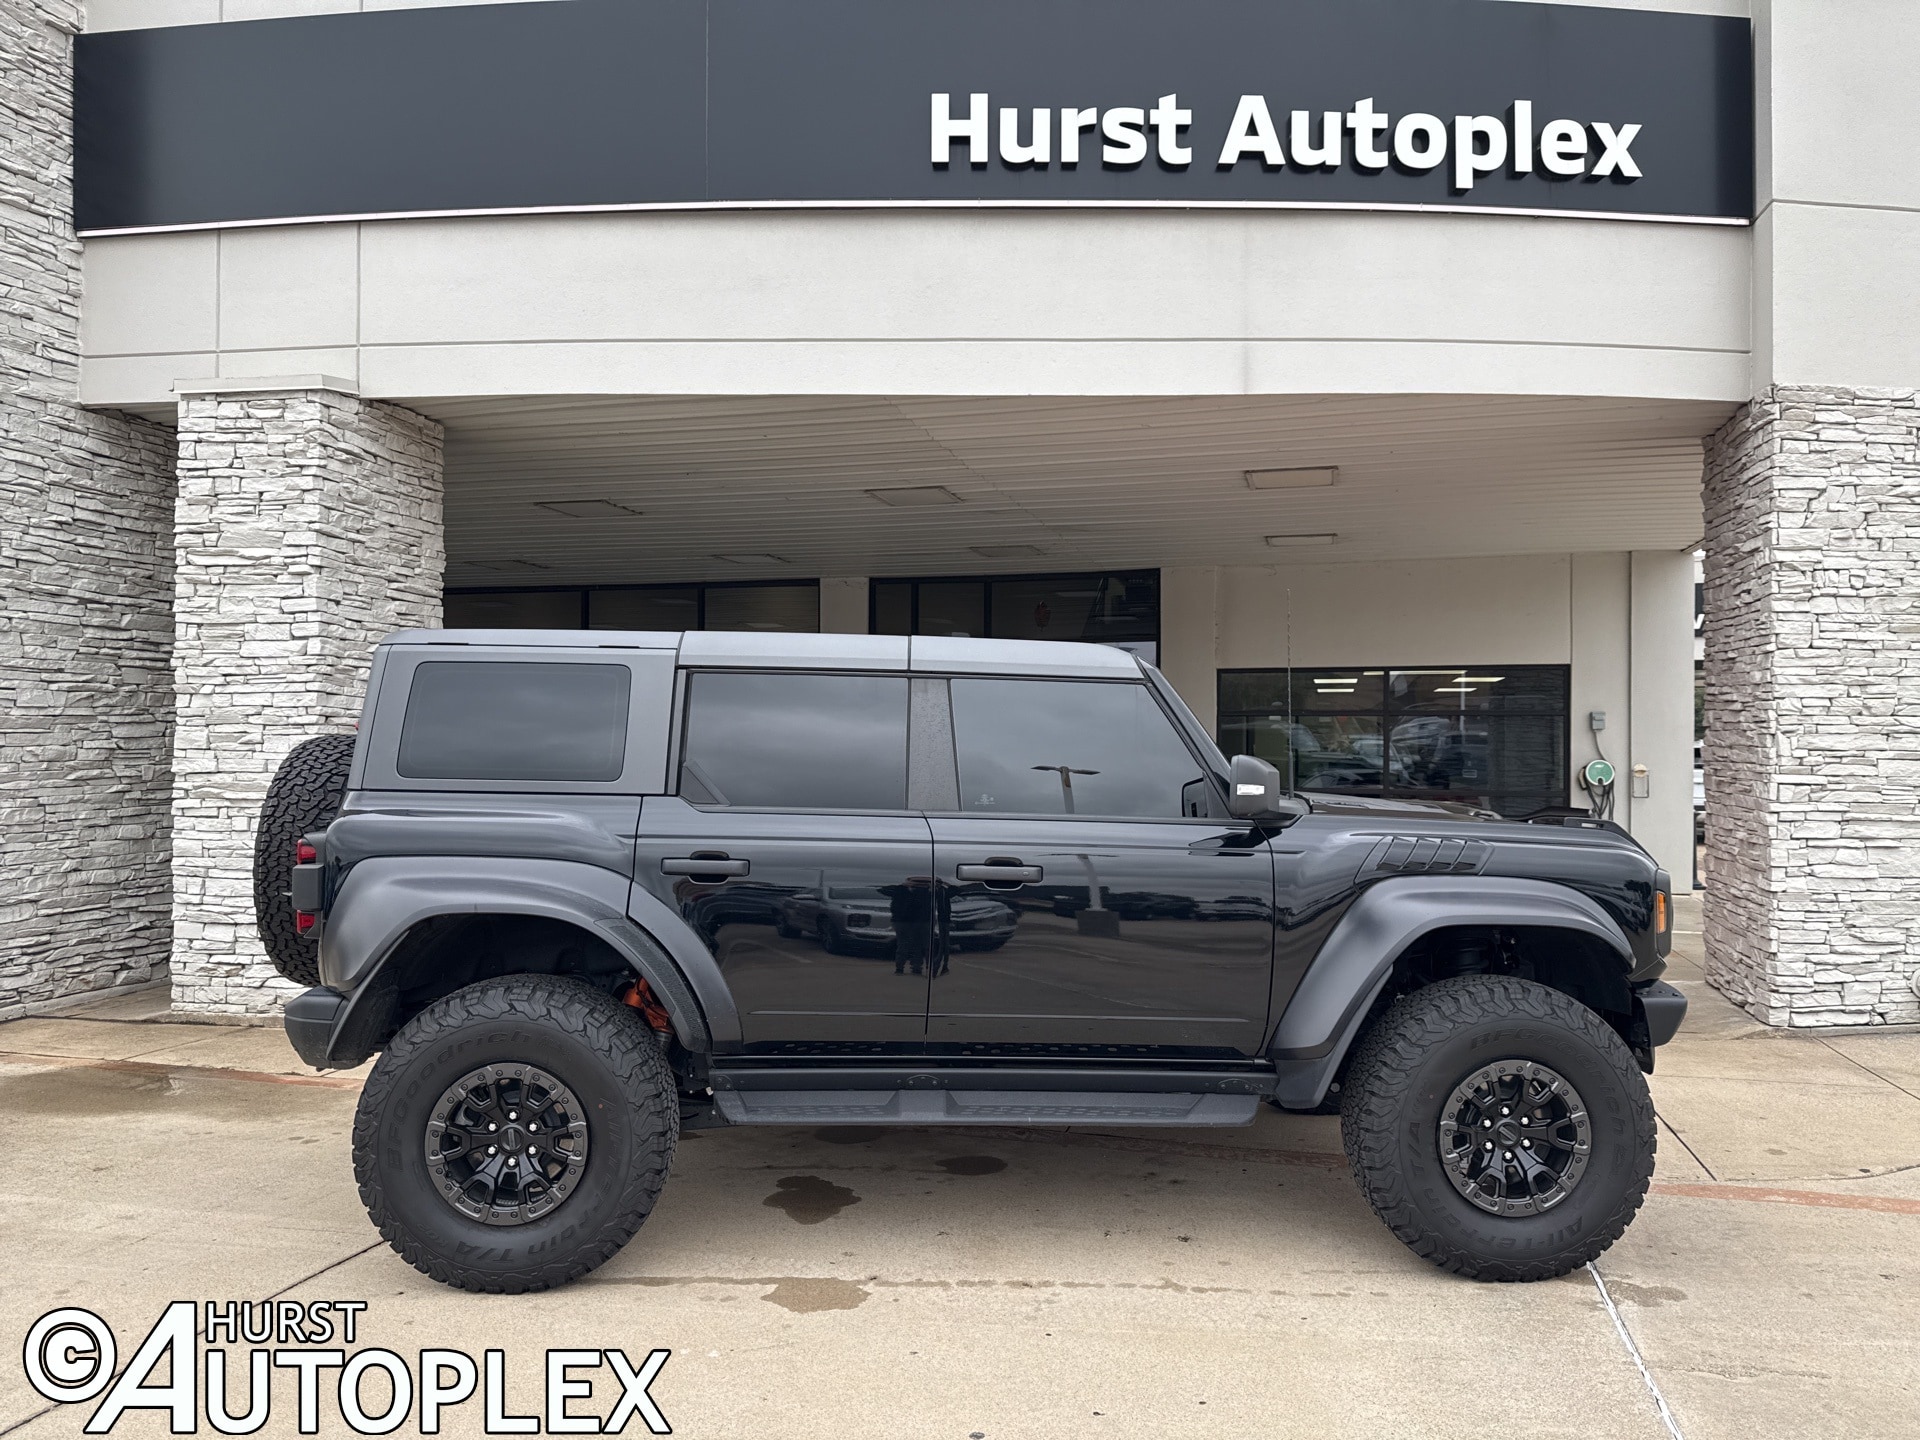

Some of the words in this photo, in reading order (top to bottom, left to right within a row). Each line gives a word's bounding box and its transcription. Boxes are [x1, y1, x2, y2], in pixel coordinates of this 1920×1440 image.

[931, 93, 1192, 164] Hurst
[1218, 95, 1643, 190] Autoplex
[387, 1031, 531, 1172] BFGoodrich
